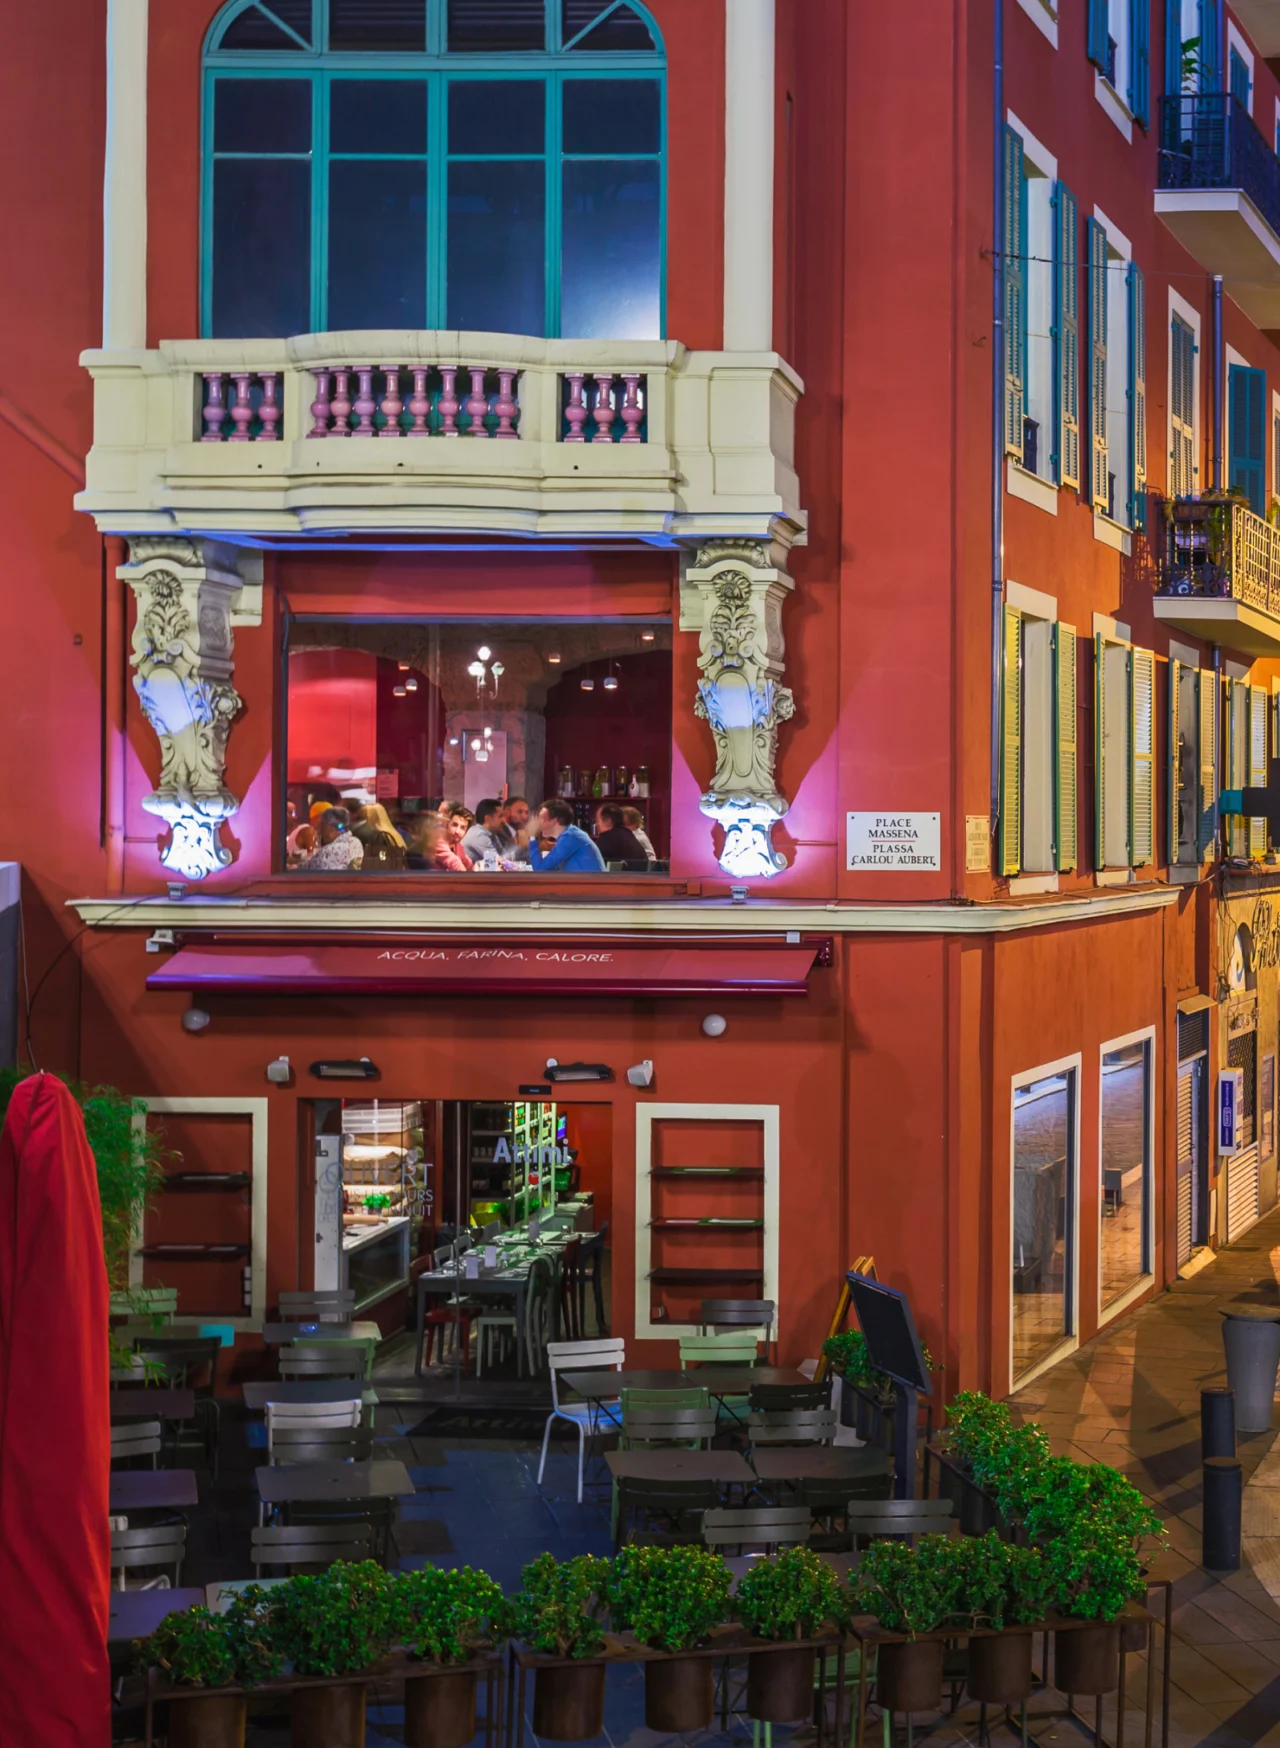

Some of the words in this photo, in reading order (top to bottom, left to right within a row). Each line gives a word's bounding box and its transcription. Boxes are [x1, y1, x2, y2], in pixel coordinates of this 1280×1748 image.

[876, 818, 912, 828] PLACE
[868, 829, 918, 839] MASSENA
[873, 844, 914, 854] PLASSA
[852, 855, 894, 864] CARLOU
[897, 855, 935, 864] AUBERT
[377, 950, 450, 961] ACQUA.
[457, 950, 528, 961] FARINA.
[536, 952, 614, 962] CALORE.
[492, 1137, 570, 1164] Attimi
[325, 1162, 433, 1186] OUVERT
